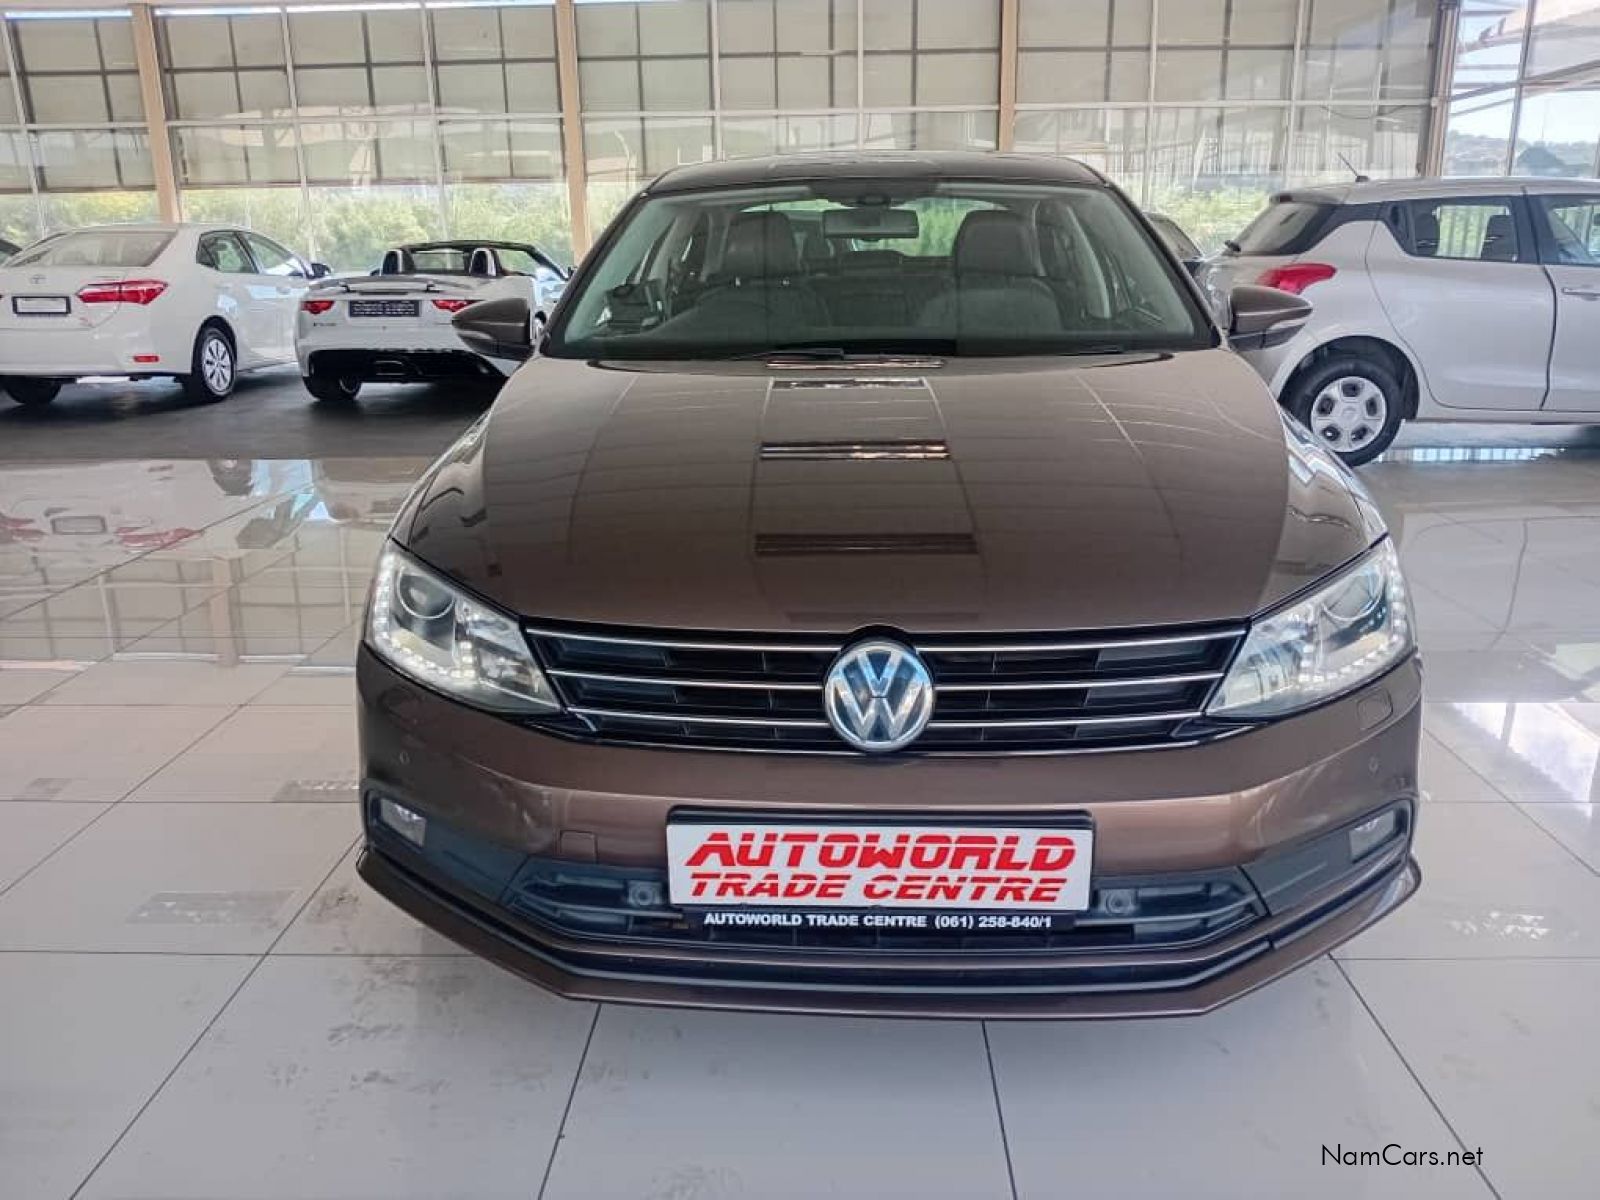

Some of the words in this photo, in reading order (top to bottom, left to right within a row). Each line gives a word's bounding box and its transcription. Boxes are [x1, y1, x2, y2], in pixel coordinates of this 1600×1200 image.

[685, 832, 1077, 872] AUTOWORLD
[689, 872, 852, 899] TRADE
[863, 874, 1068, 903] CENTRE
[704, 912, 802, 926] AUTOWORLD
[806, 914, 859, 927] TRADE
[863, 914, 927, 928] CENTRE
[934, 914, 974, 929] (061)
